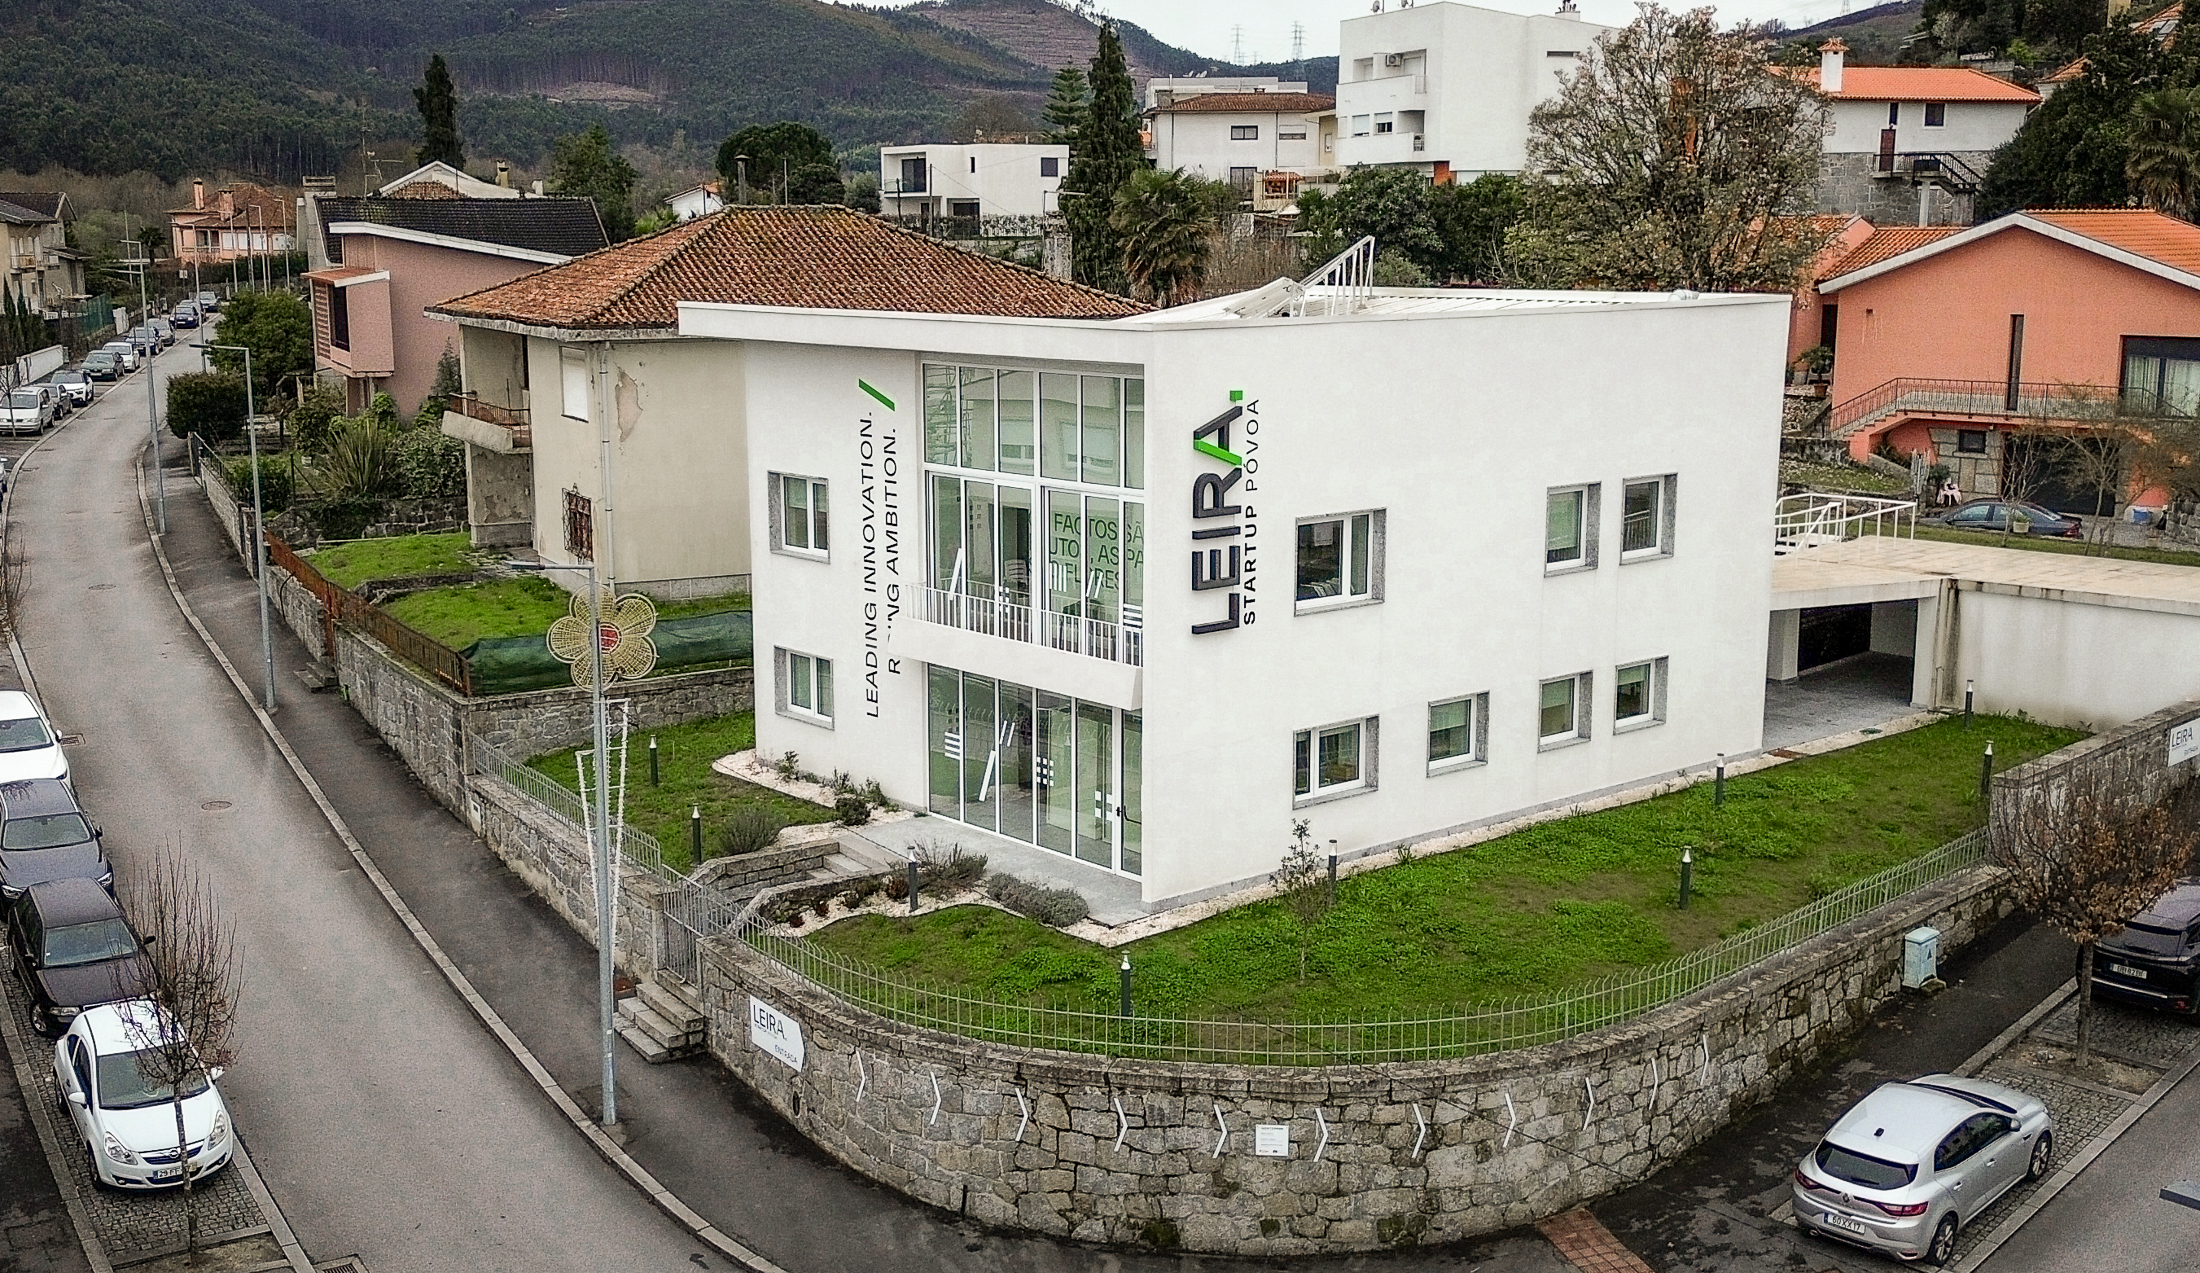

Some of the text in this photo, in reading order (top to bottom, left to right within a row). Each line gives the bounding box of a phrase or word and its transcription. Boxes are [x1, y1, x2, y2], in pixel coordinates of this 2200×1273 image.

[860, 411, 879, 718] LEADING INNOVATION.
[883, 428, 900, 576] AMBITION.
[1243, 399, 1259, 625] STARTUP PÓVOA
